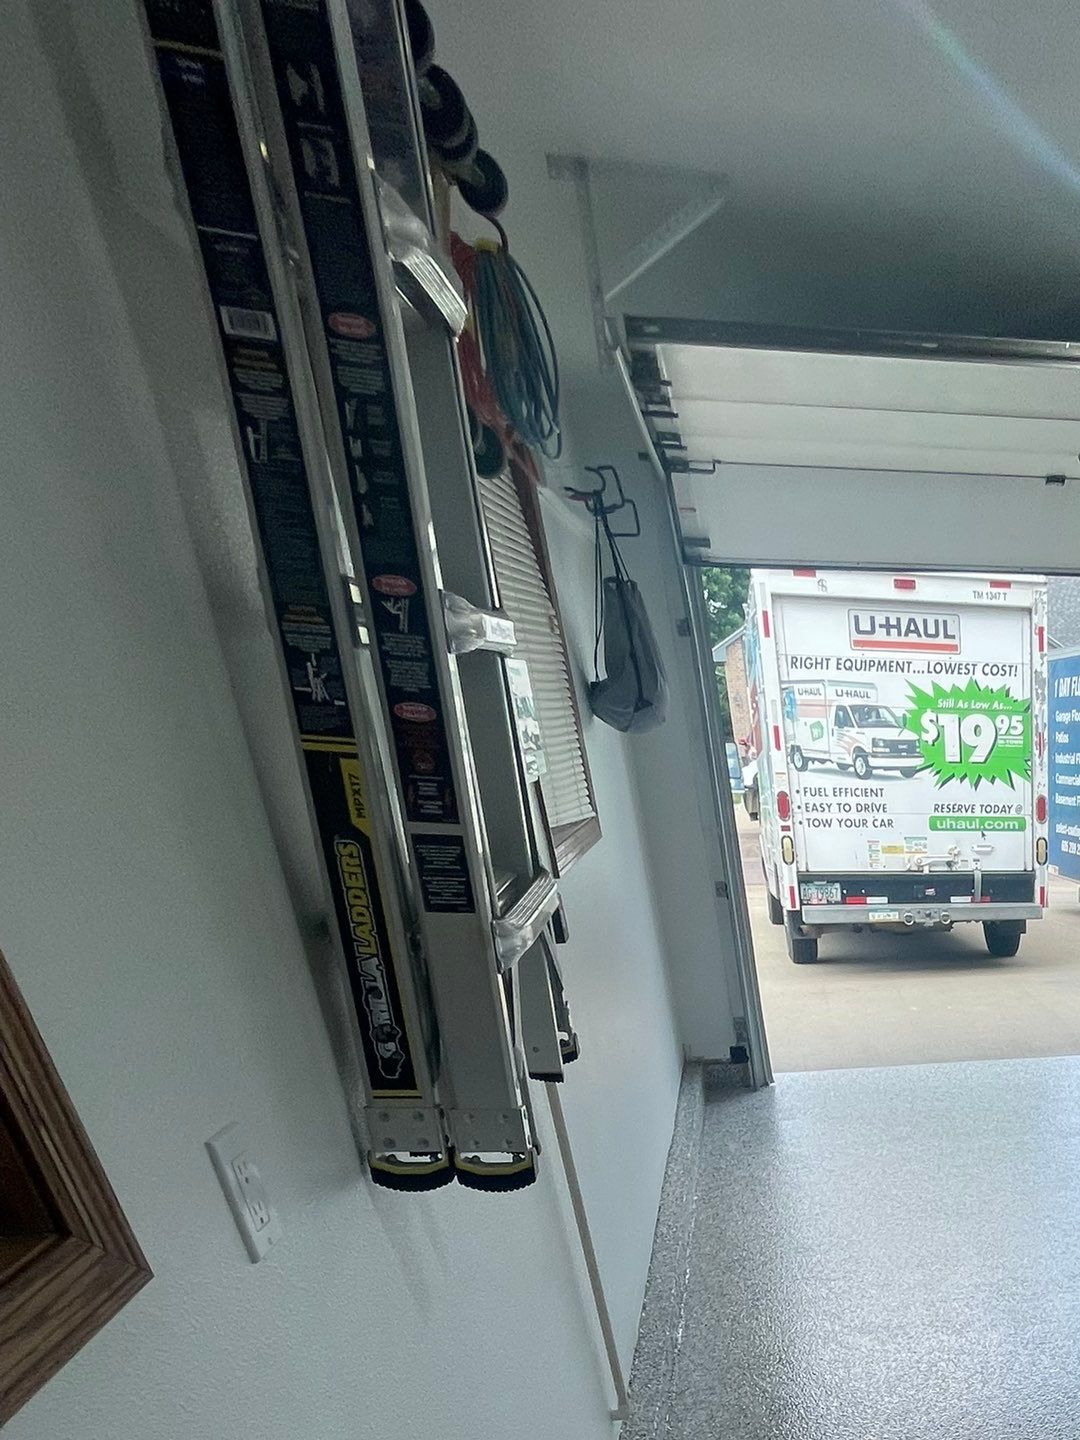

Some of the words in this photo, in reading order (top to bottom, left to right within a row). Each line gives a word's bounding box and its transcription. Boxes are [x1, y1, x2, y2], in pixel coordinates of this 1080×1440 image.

[973, 591, 984, 599] TM
[790, 656, 831, 670] RIGHT
[982, 663, 1018, 677] COST!
[937, 699, 955, 709] Still
[956, 699, 968, 709] As
[971, 700, 990, 709] Low
[1055, 710, 1071, 724] Garage
[803, 787, 829, 797] FUEL
[832, 787, 884, 798] EFFICIENT
[804, 802, 832, 813] EASY
[836, 803, 852, 813] TO
[856, 802, 888, 813] DRIVE
[933, 803, 976, 814] RESERVE
[980, 804, 1013, 814] TODAY
[806, 818, 833, 828] TOW
[836, 818, 868, 828] YOUR
[872, 818, 894, 828] CAR
[936, 818, 1019, 829] uhaul.com
[337, 842, 378, 958] LADDERS
